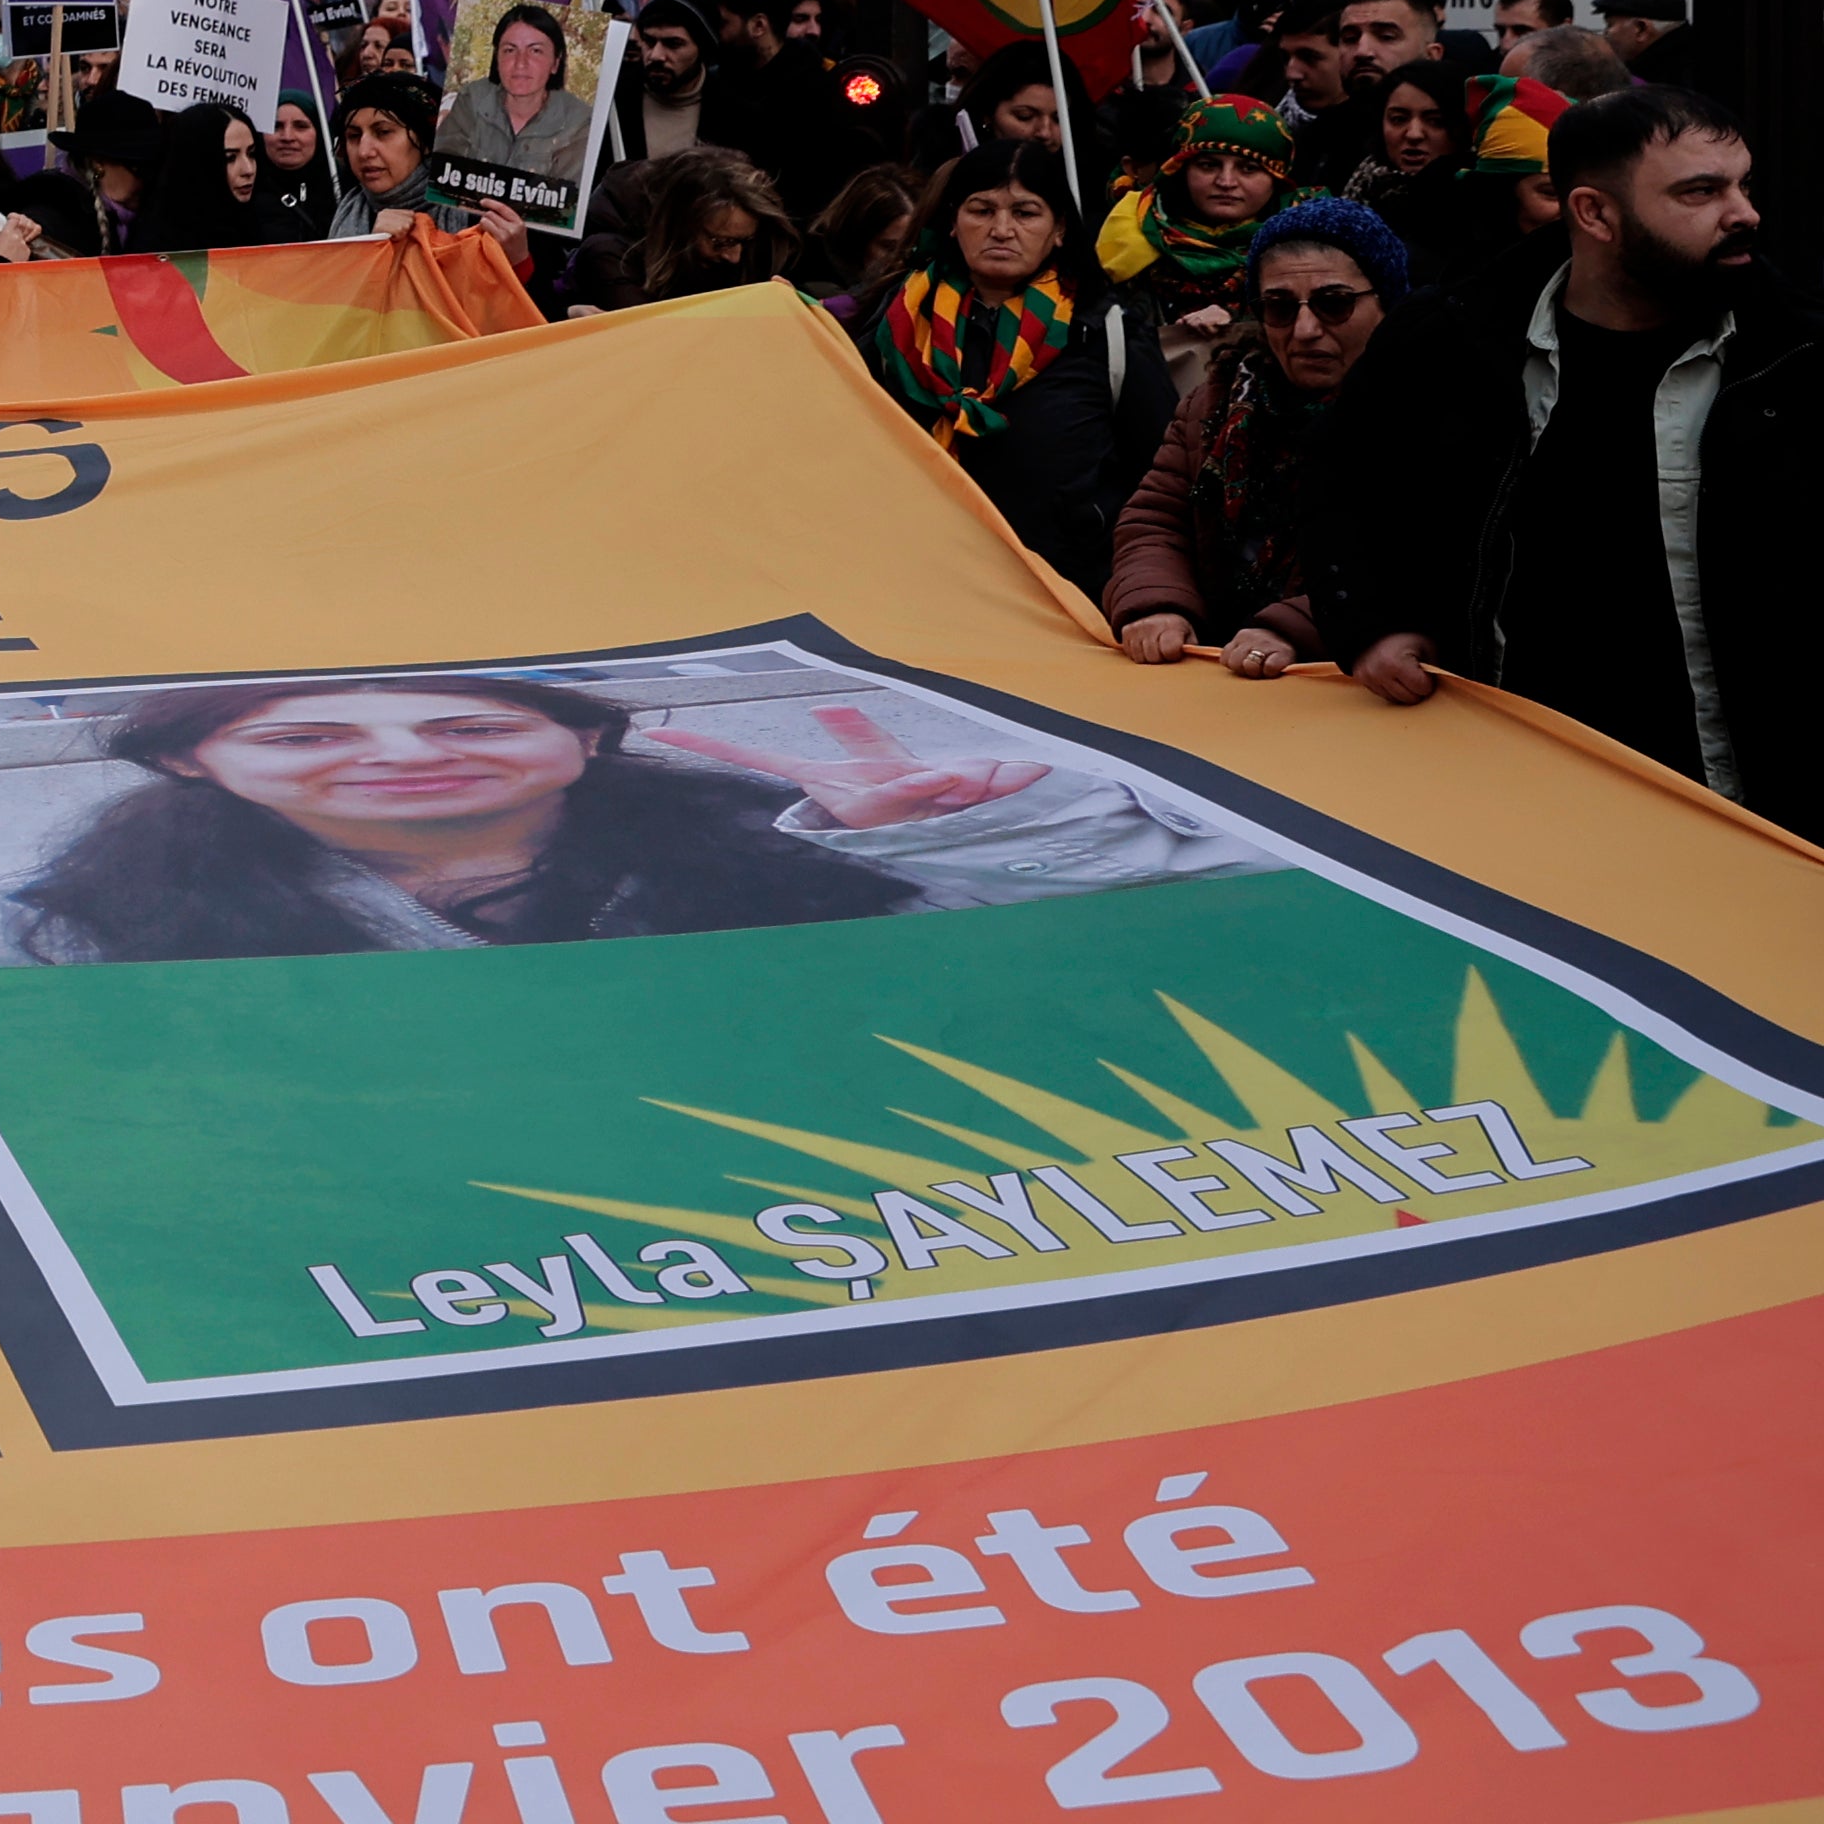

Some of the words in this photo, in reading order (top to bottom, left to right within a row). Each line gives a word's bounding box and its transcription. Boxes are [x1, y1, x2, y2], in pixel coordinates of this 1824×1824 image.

[22, 15, 35, 27] ET
[36, 7, 107, 25] CODAMNÉS
[170, 9, 252, 43] VENGEANCE
[193, 38, 227, 60] SERA
[146, 53, 168, 71] LA
[173, 56, 258, 92] RÉVOLUTION
[157, 79, 188, 98] DES
[192, 85, 249, 114] FEMMES!
[436, 162, 462, 188] Je
[464, 172, 507, 198] suis
[509, 176, 568, 210] Evîn!
[304, 1226, 754, 1341] Leyla
[751, 1098, 1599, 1303] ŞAYLEMEZ
[257, 1547, 753, 1691] ont
[821, 1469, 1318, 1637] été
[998, 1603, 1762, 1814] 2013
